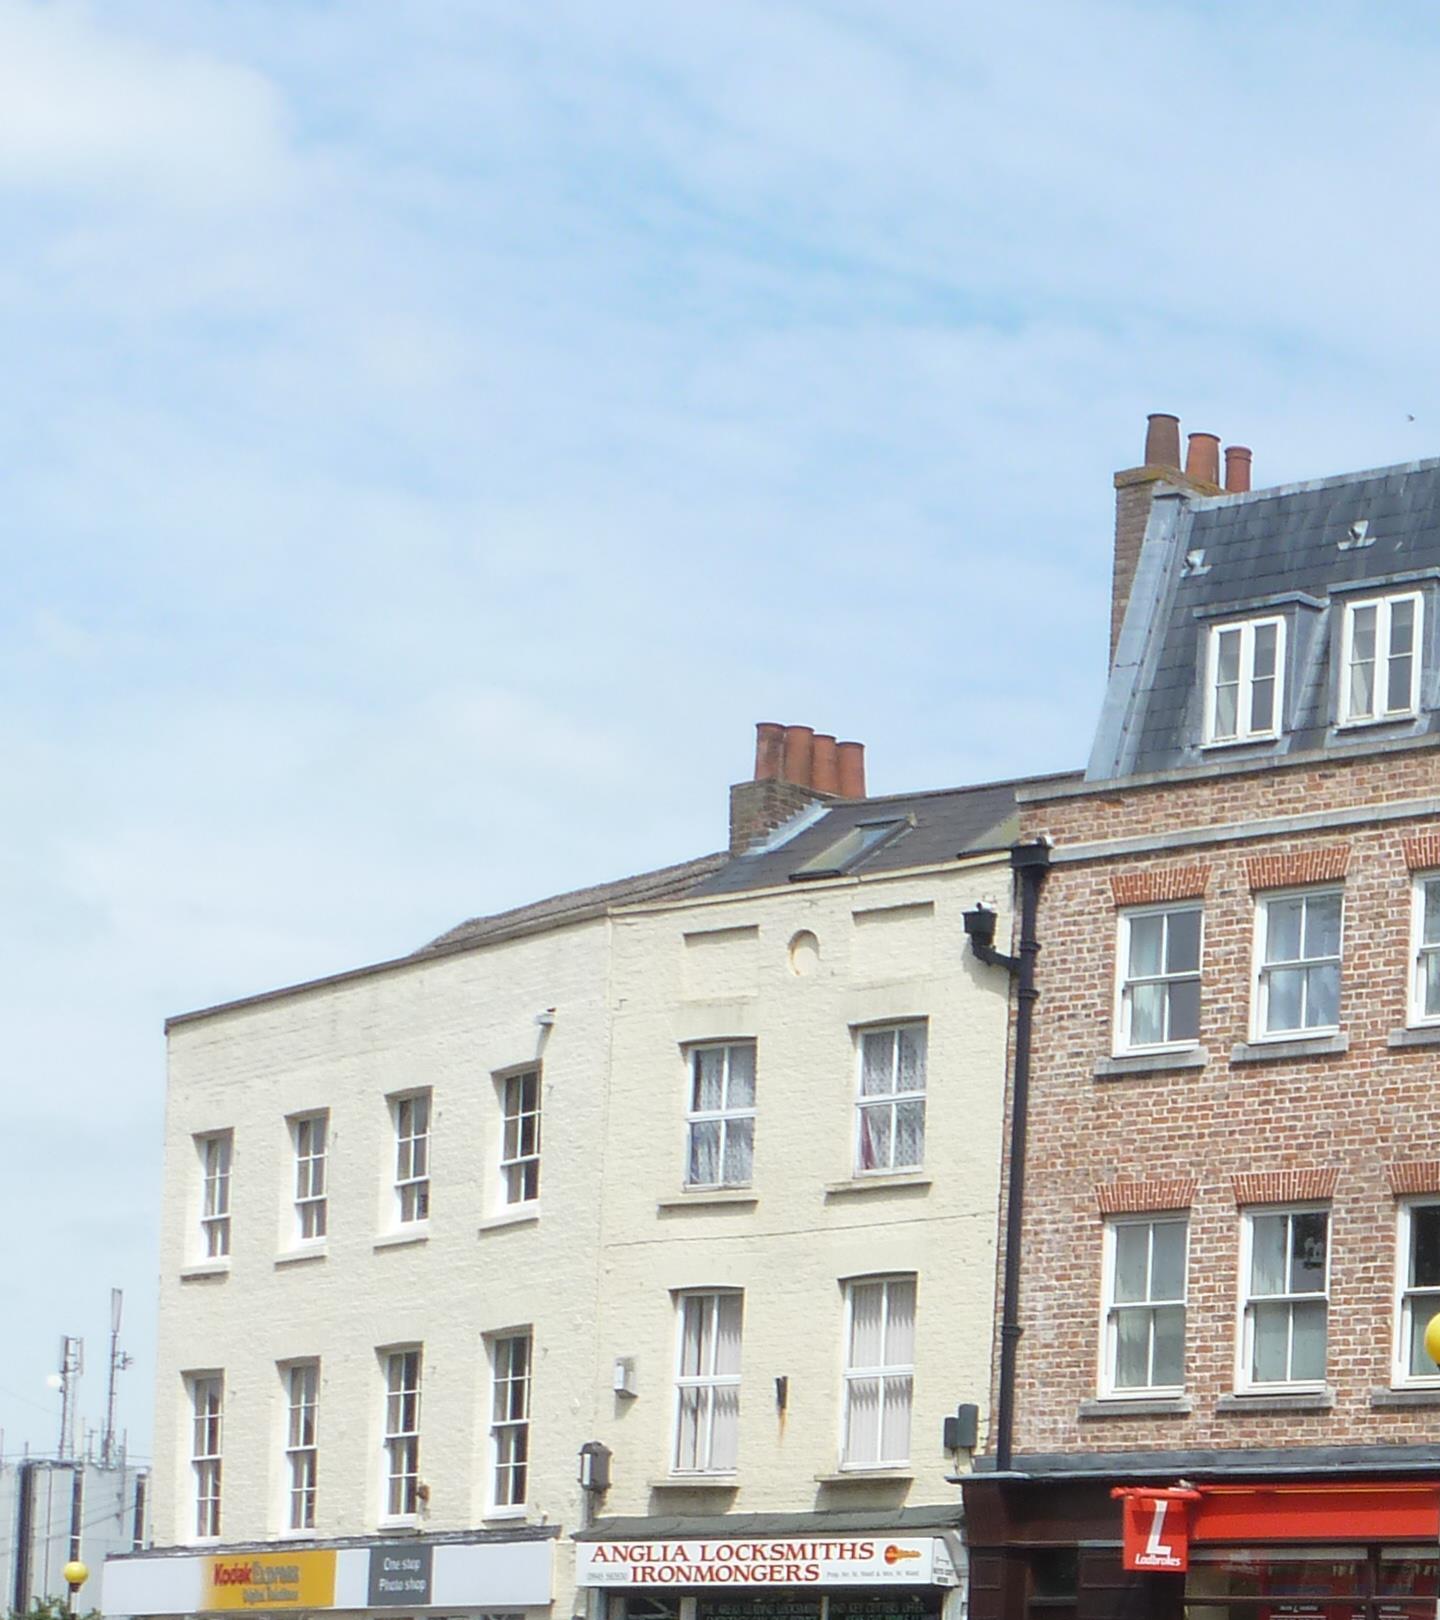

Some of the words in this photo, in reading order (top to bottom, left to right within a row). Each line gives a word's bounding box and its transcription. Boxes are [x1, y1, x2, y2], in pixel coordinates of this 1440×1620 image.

[1145, 1500, 1171, 1554] L
[591, 1545, 690, 1562] ANGLIA
[700, 1542, 875, 1561] LOCKSMITHS
[1135, 1553, 1181, 1567] Ladbrokes
[384, 1557, 400, 1571] One
[402, 1558, 420, 1572] stop
[631, 1564, 820, 1583] IRONMONGERS
[214, 1563, 251, 1586] Kodak
[405, 1578, 426, 1593] shop
